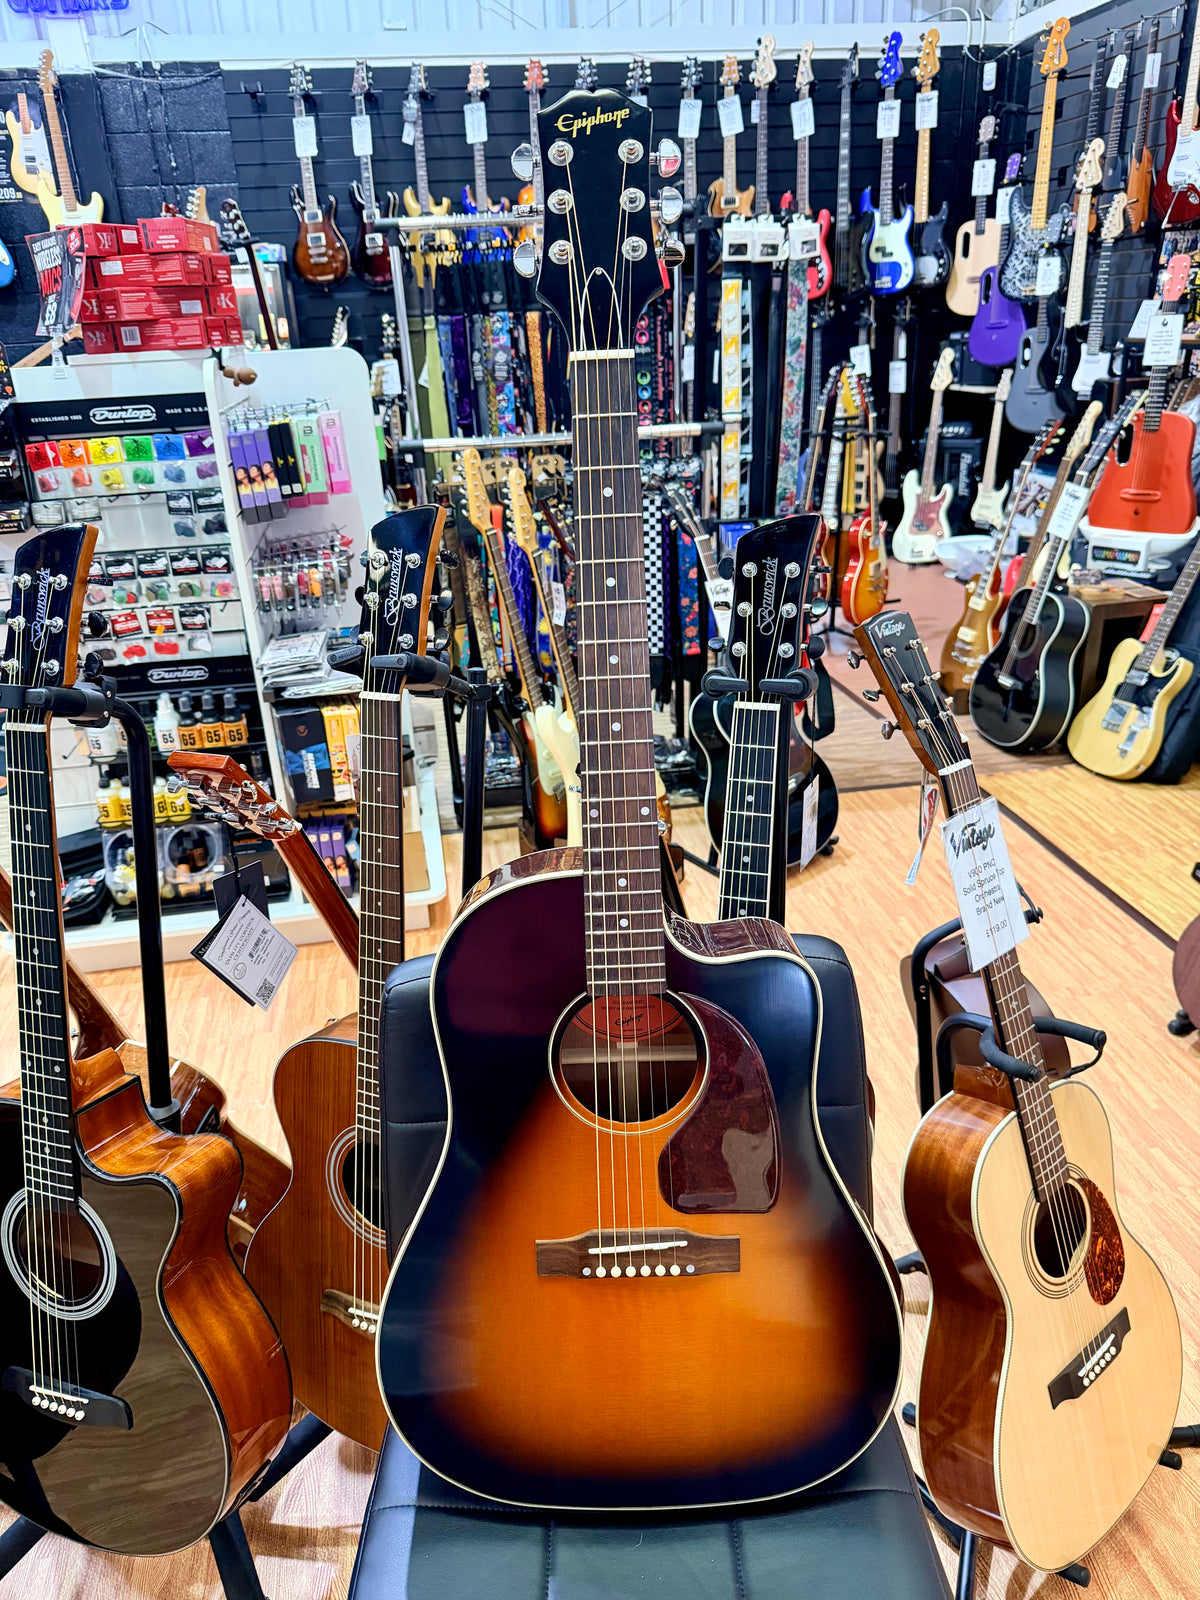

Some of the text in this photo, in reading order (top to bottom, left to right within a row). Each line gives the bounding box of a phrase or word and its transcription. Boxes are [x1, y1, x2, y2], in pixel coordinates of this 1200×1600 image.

[554, 106, 630, 138] Epiphone
[40, 265, 62, 297] MICS
[30, 415, 70, 424] ESTABLISHED
[93, 407, 153, 421] Dunlop
[383, 547, 403, 626] Brunswick
[756, 556, 778, 636] Brunswick
[30, 567, 50, 651] Brunswick
[875, 619, 905, 639] Vintage
[151, 668, 207, 681] Dunlop
[162, 733, 175, 744] 65
[181, 733, 196, 746] 65
[206, 729, 221, 743] 65
[229, 728, 243, 742] 65
[950, 817, 995, 859] Vintage
[962, 867, 1005, 896] Solid Spruce Top
[974, 886, 1000, 903] Orchestra
[976, 896, 1005, 916] Brand New
